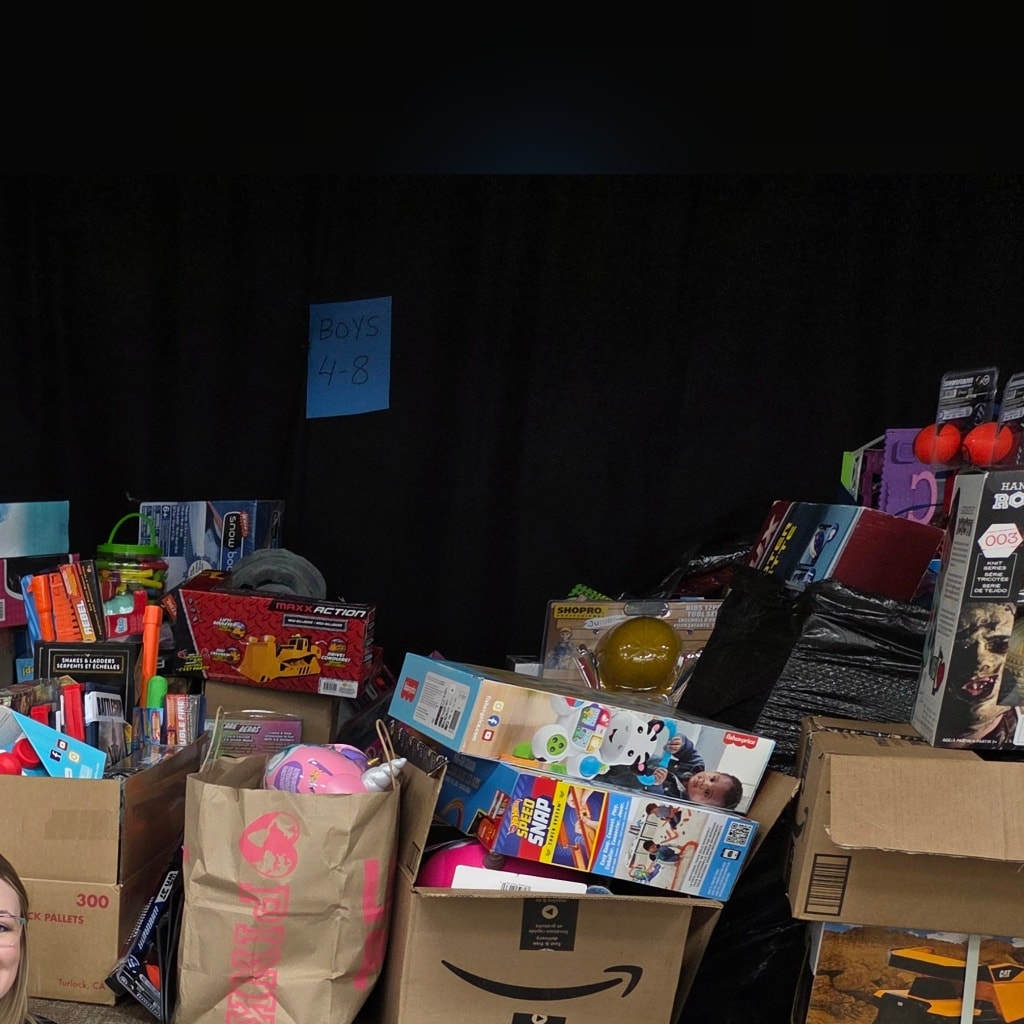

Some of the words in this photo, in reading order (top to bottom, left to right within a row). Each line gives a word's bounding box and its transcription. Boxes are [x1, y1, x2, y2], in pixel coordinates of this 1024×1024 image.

[320, 315, 380, 341] BOYS
[319, 355, 369, 386] 4-8
[228, 515, 237, 548] snow
[985, 532, 1018, 547] 003
[276, 602, 313, 613] MAXX
[313, 606, 367, 618] ACTION
[725, 733, 757, 746] fisher-price
[516, 798, 535, 839] SPEED
[528, 797, 552, 847] SNAP
[76, 893, 109, 909] 300
[45, 913, 84, 924] PALLETS
[999, 970, 1012, 978] CAT
[58, 978, 89, 990] Turlock,
[92, 982, 105, 990] CA
